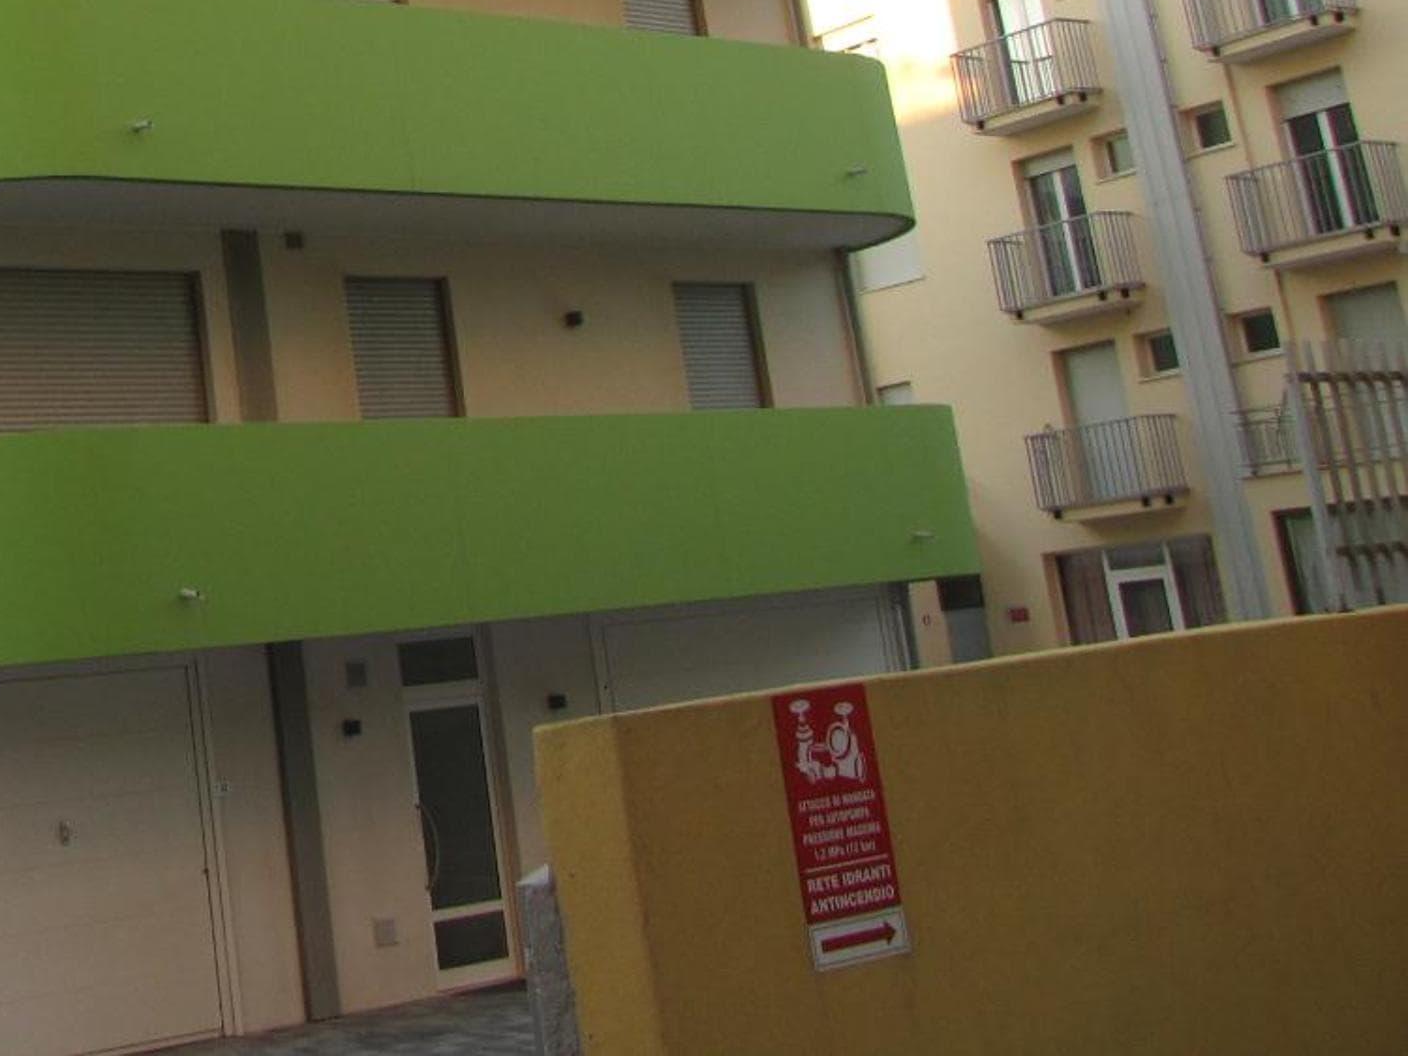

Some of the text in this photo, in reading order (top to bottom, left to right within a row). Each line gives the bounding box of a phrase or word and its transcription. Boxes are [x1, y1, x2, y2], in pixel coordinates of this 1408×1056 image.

[807, 864, 892, 893] RETE IDRANTI
[811, 884, 894, 915] ANTINCENDIO
